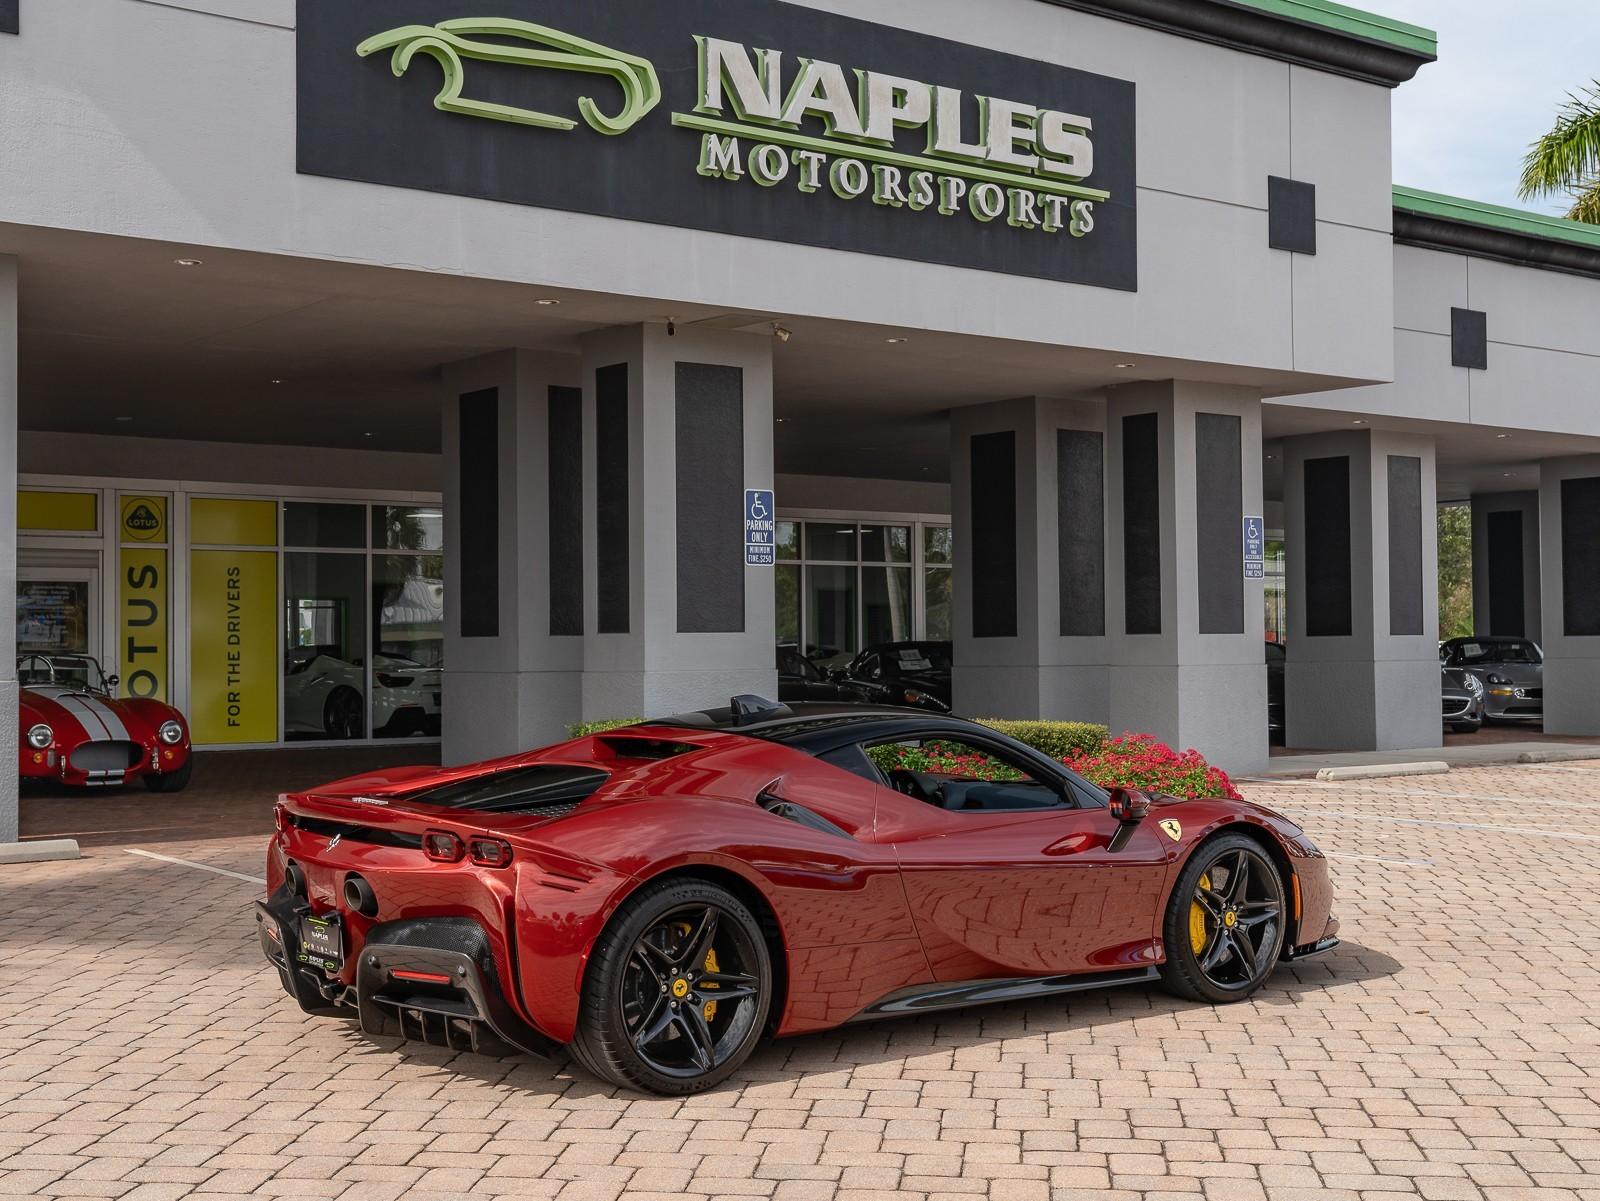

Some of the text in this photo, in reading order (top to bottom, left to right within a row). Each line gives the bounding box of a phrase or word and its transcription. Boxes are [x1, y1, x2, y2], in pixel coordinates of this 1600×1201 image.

[692, 34, 1094, 182] NAPLES
[697, 132, 1094, 238] MOTORSPORTS
[129, 519, 157, 527] LOTUS
[747, 519, 773, 531] PARKING
[749, 546, 771, 554] MINIMUM
[751, 532, 768, 543] ONLY
[127, 565, 159, 699] OTUS
[227, 566, 241, 727] FOR THE DRIVERS
